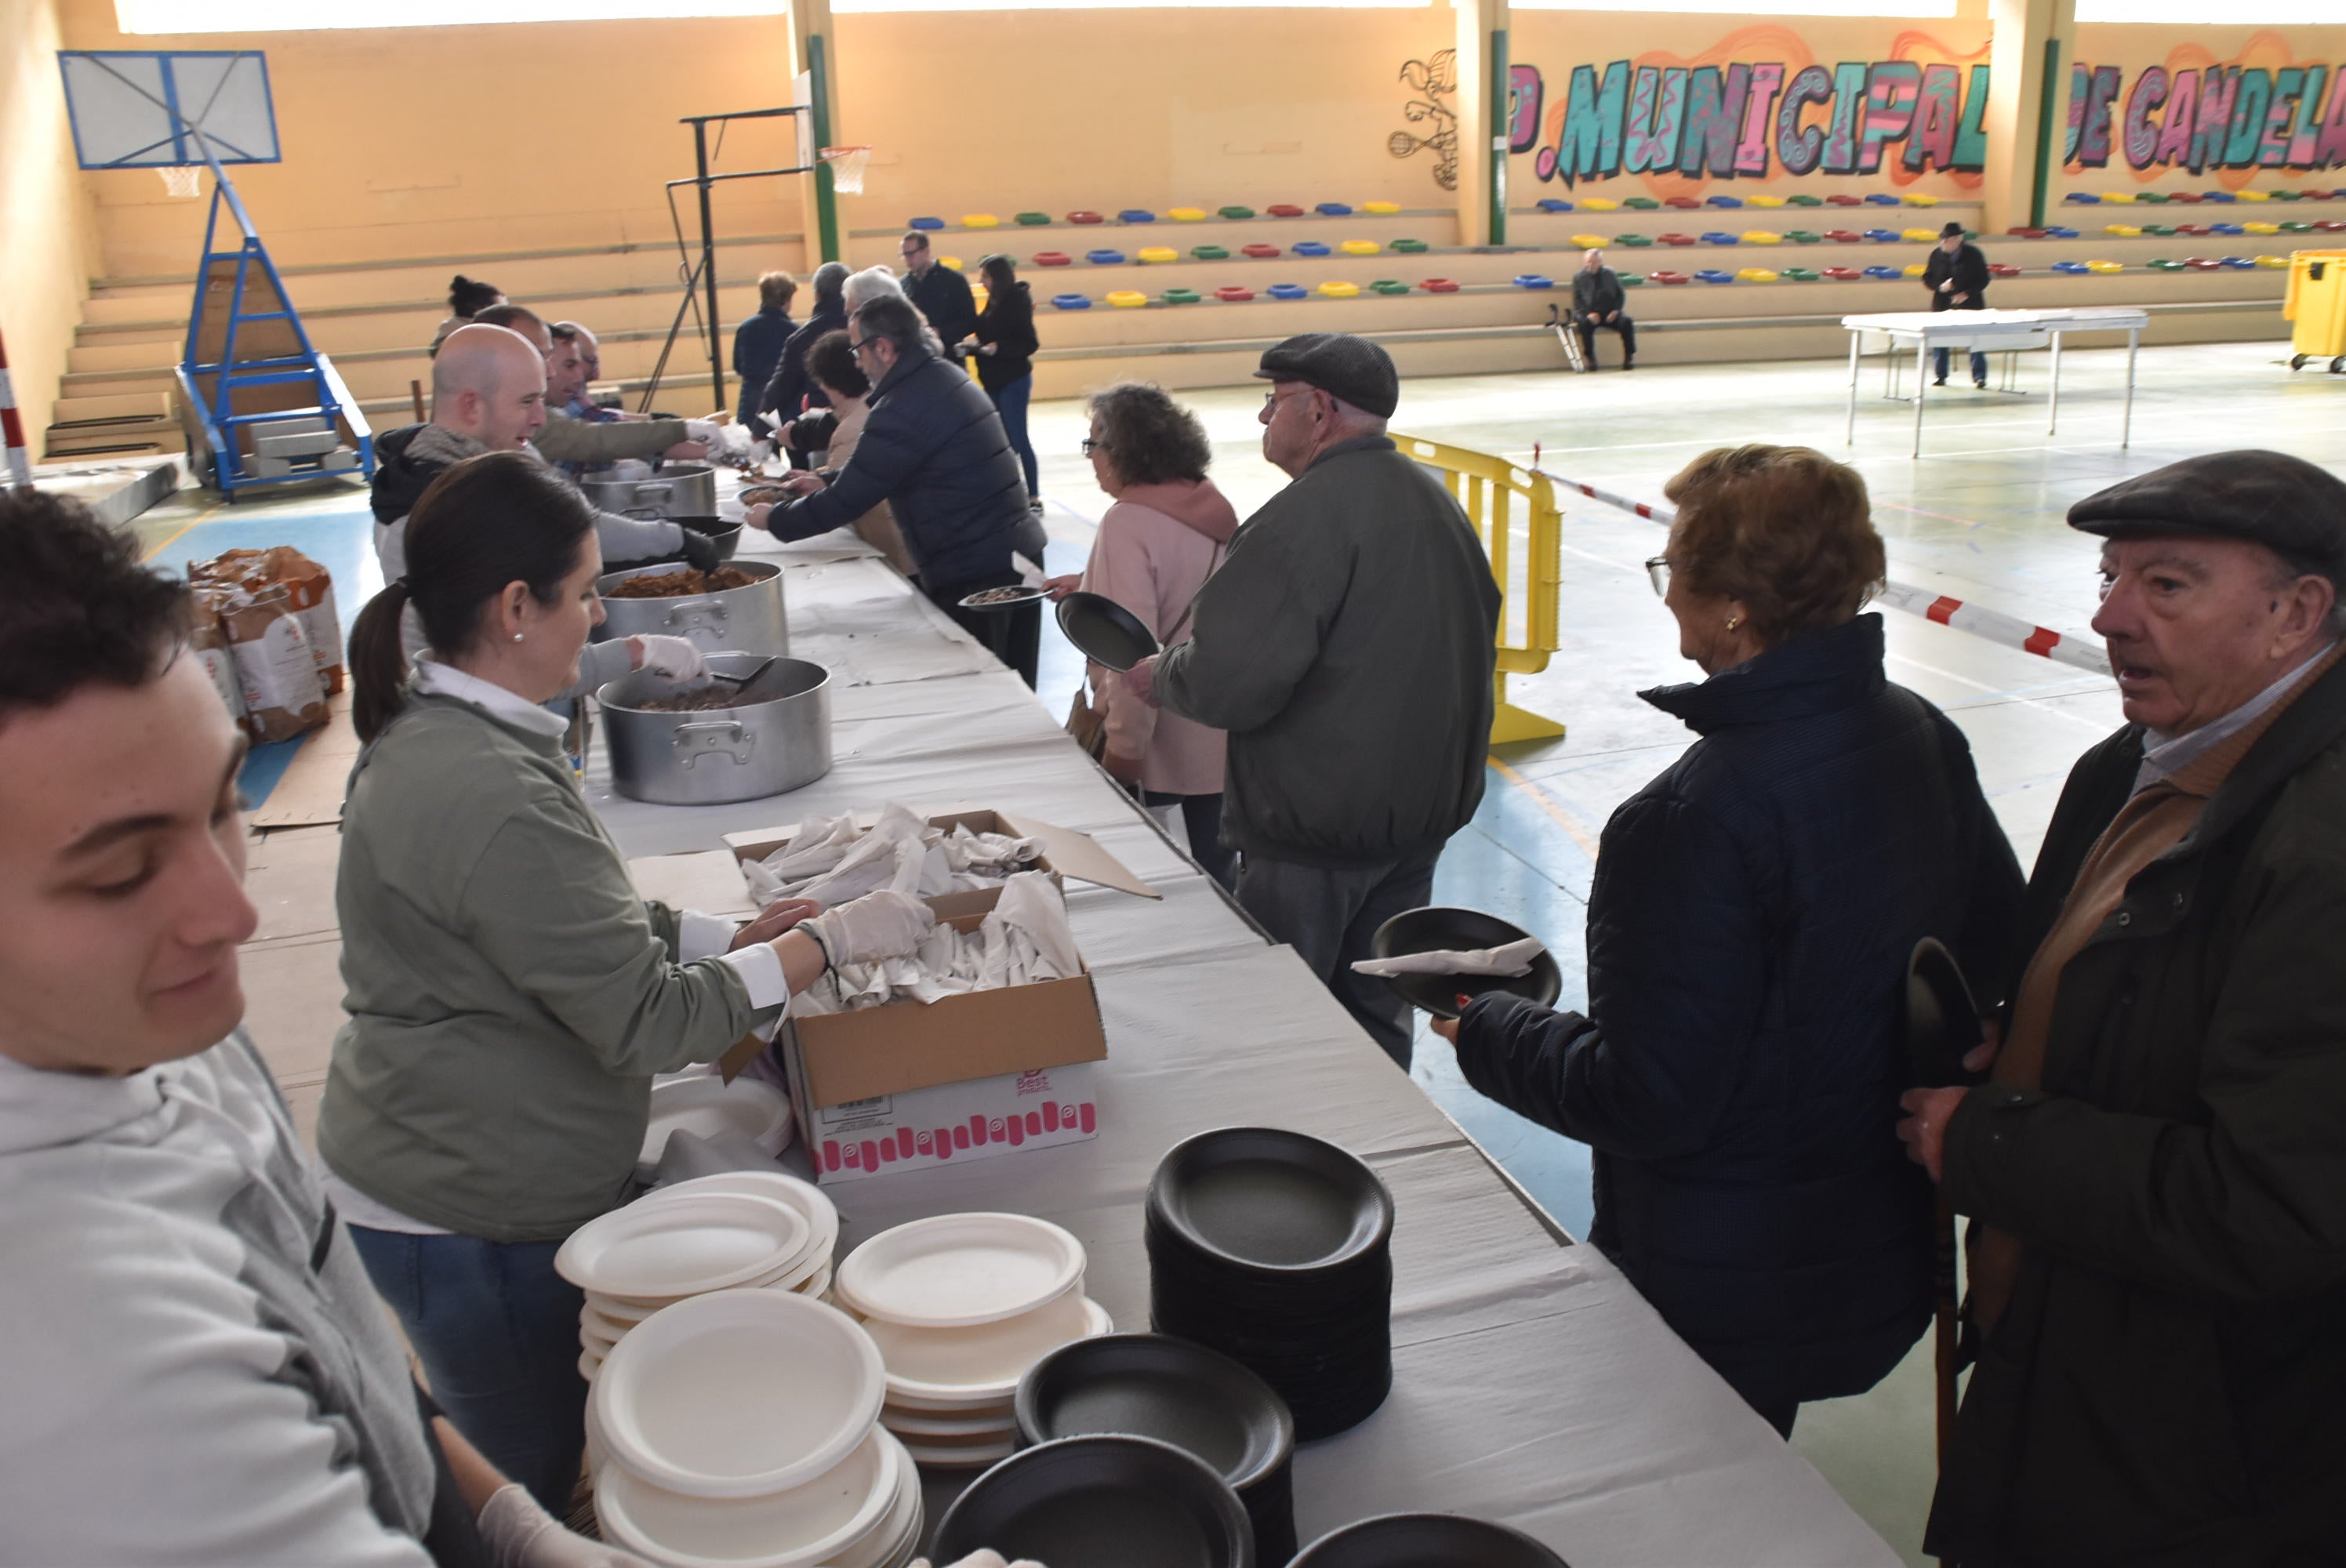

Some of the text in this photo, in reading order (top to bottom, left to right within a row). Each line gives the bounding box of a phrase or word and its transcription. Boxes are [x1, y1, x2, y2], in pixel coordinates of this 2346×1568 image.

[1556, 60, 1990, 191] MUNICIPAL
[2124, 64, 2346, 176] CANDELA
[1016, 1076, 1049, 1090] Best
